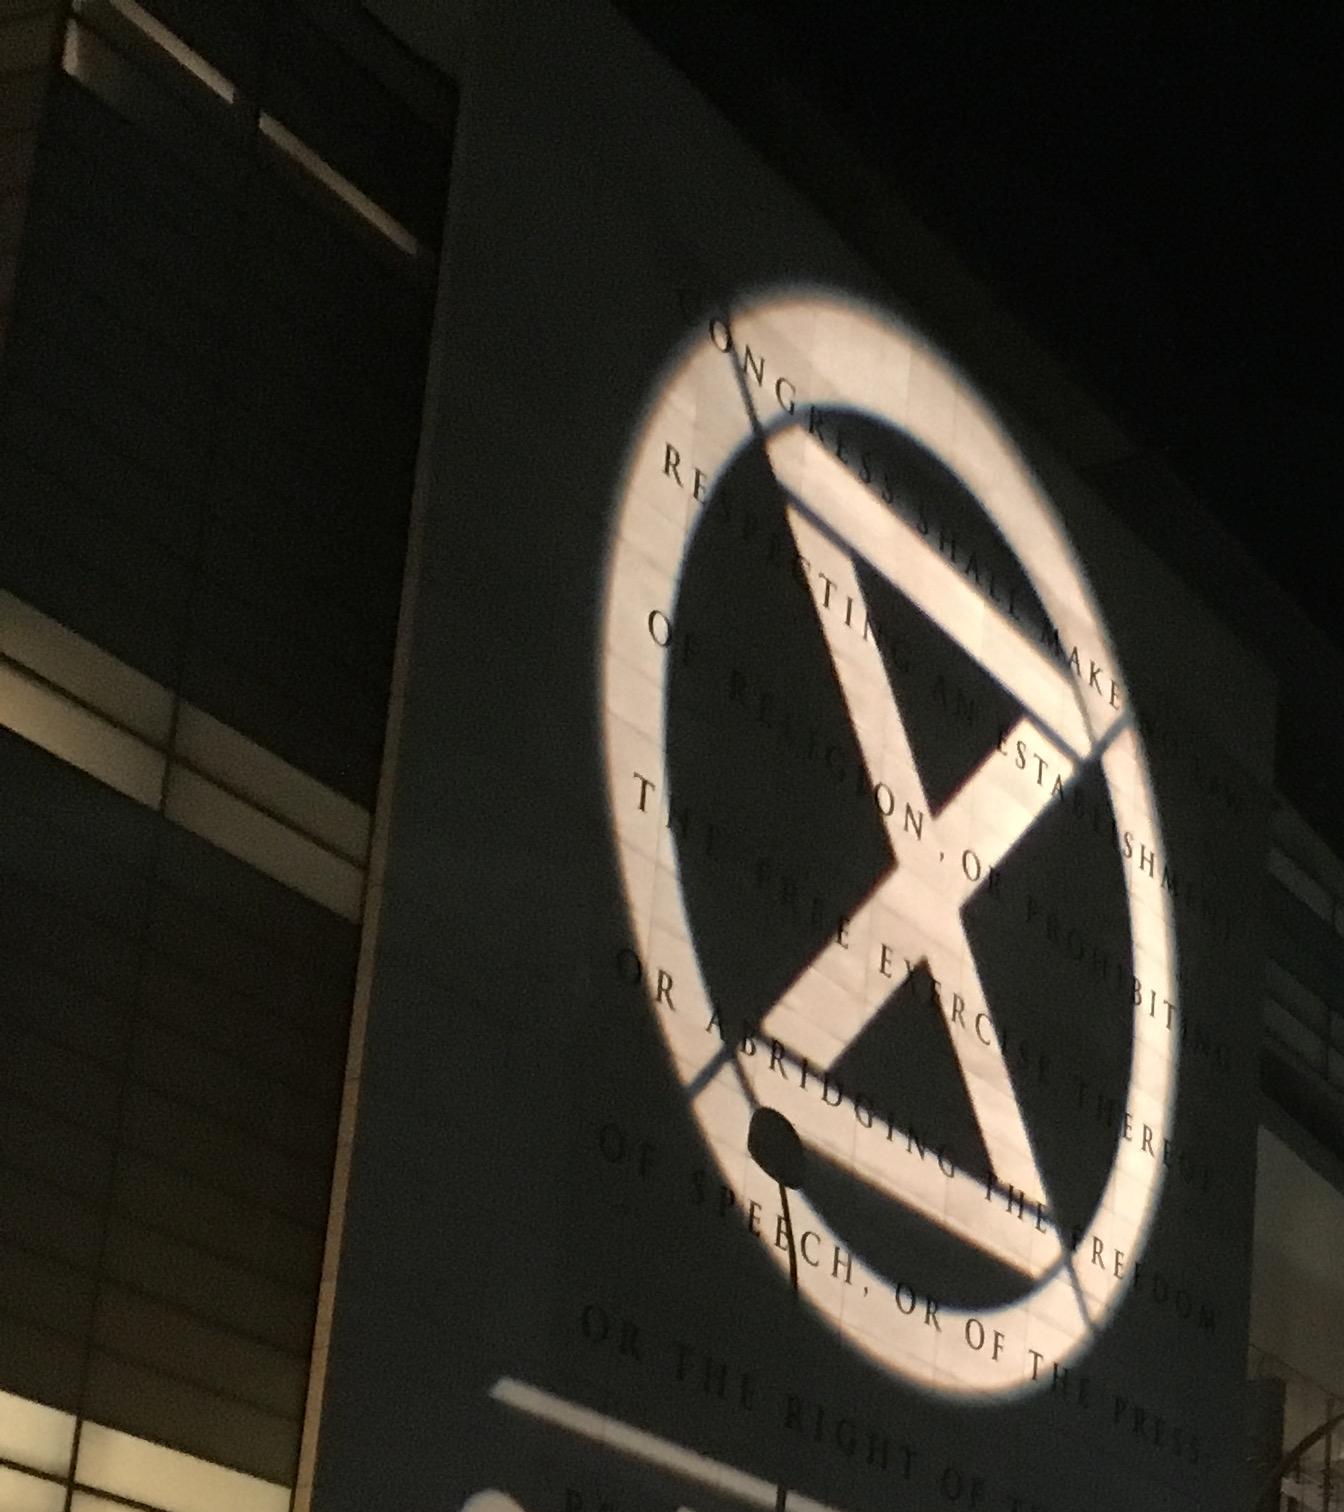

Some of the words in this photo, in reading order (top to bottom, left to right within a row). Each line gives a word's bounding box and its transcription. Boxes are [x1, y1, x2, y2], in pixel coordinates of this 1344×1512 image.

[1037, 622, 1127, 713] MAKE
[616, 947, 679, 1012] OR
[705, 997, 957, 1181] ABRIDGING
[984, 1168, 1052, 1233] THE
[600, 1122, 656, 1178] OF
[895, 1281, 943, 1332] OR
[965, 1317, 1005, 1361] OF
[1028, 1350, 1092, 1411] THE
[580, 1303, 642, 1362] OR
[674, 1340, 757, 1412] THE
[785, 1393, 921, 1482] RIGHT
[941, 1464, 986, 1510] OF
